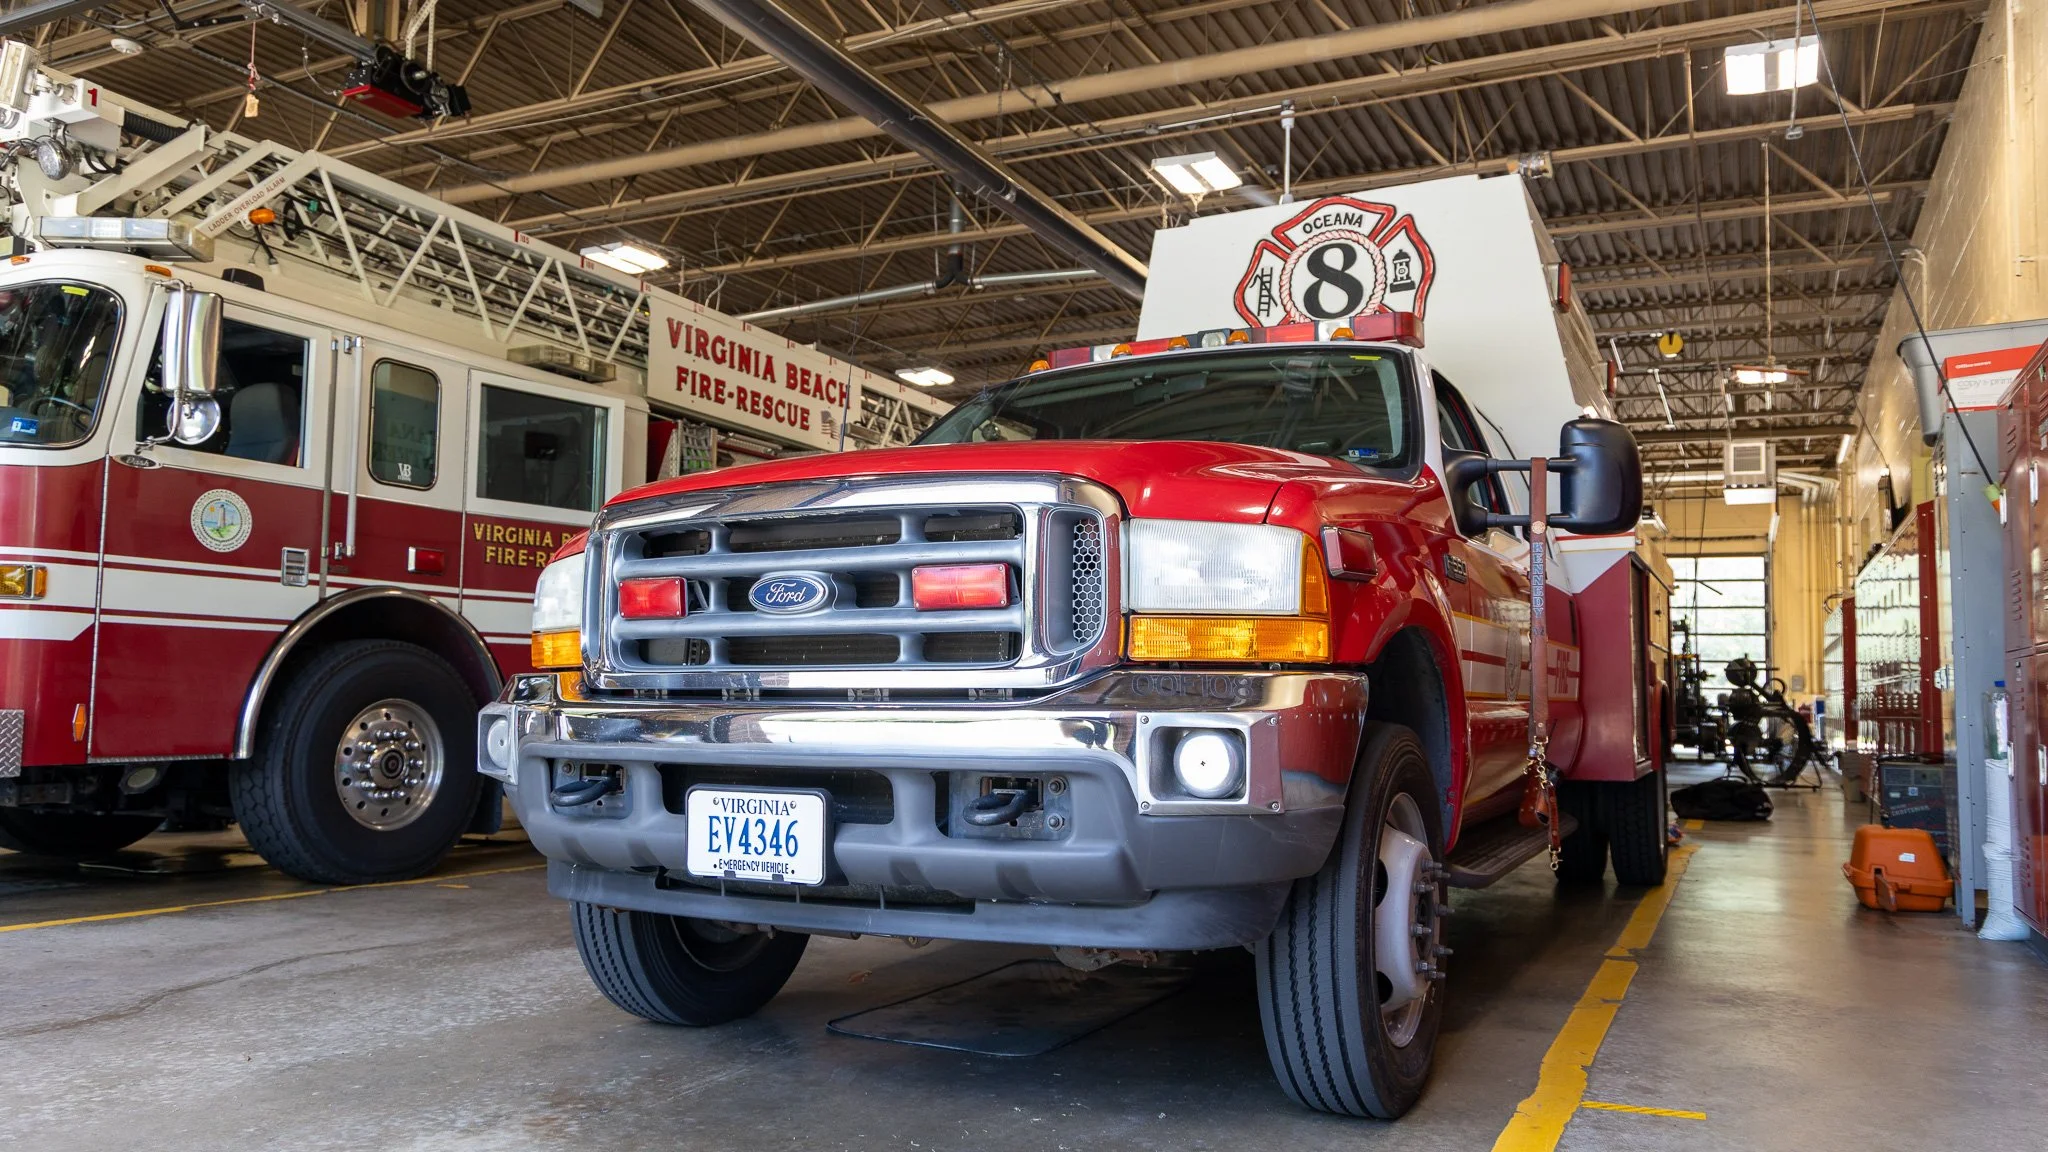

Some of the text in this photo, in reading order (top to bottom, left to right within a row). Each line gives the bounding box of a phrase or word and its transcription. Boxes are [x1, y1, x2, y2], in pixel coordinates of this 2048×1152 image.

[87, 88, 98, 107] 1
[208, 212, 233, 232] LADDER
[234, 190, 265, 214] OVERLOAD
[265, 176, 286, 193] ALARM
[1302, 212, 1364, 234] OCEANA
[1303, 242, 1364, 319] 8
[666, 316, 851, 410] VIRGINIA BEACH
[676, 365, 811, 431] FIRE-RESCUE
[473, 522, 554, 548] VIRGINIA
[765, 582, 807, 603] Ford
[1532, 541, 1544, 619] KENNEDY
[721, 797, 791, 816] VIRGINIA
[708, 815, 799, 857] EV4346
[718, 858, 789, 875] EMERGENCY VEHICLE
